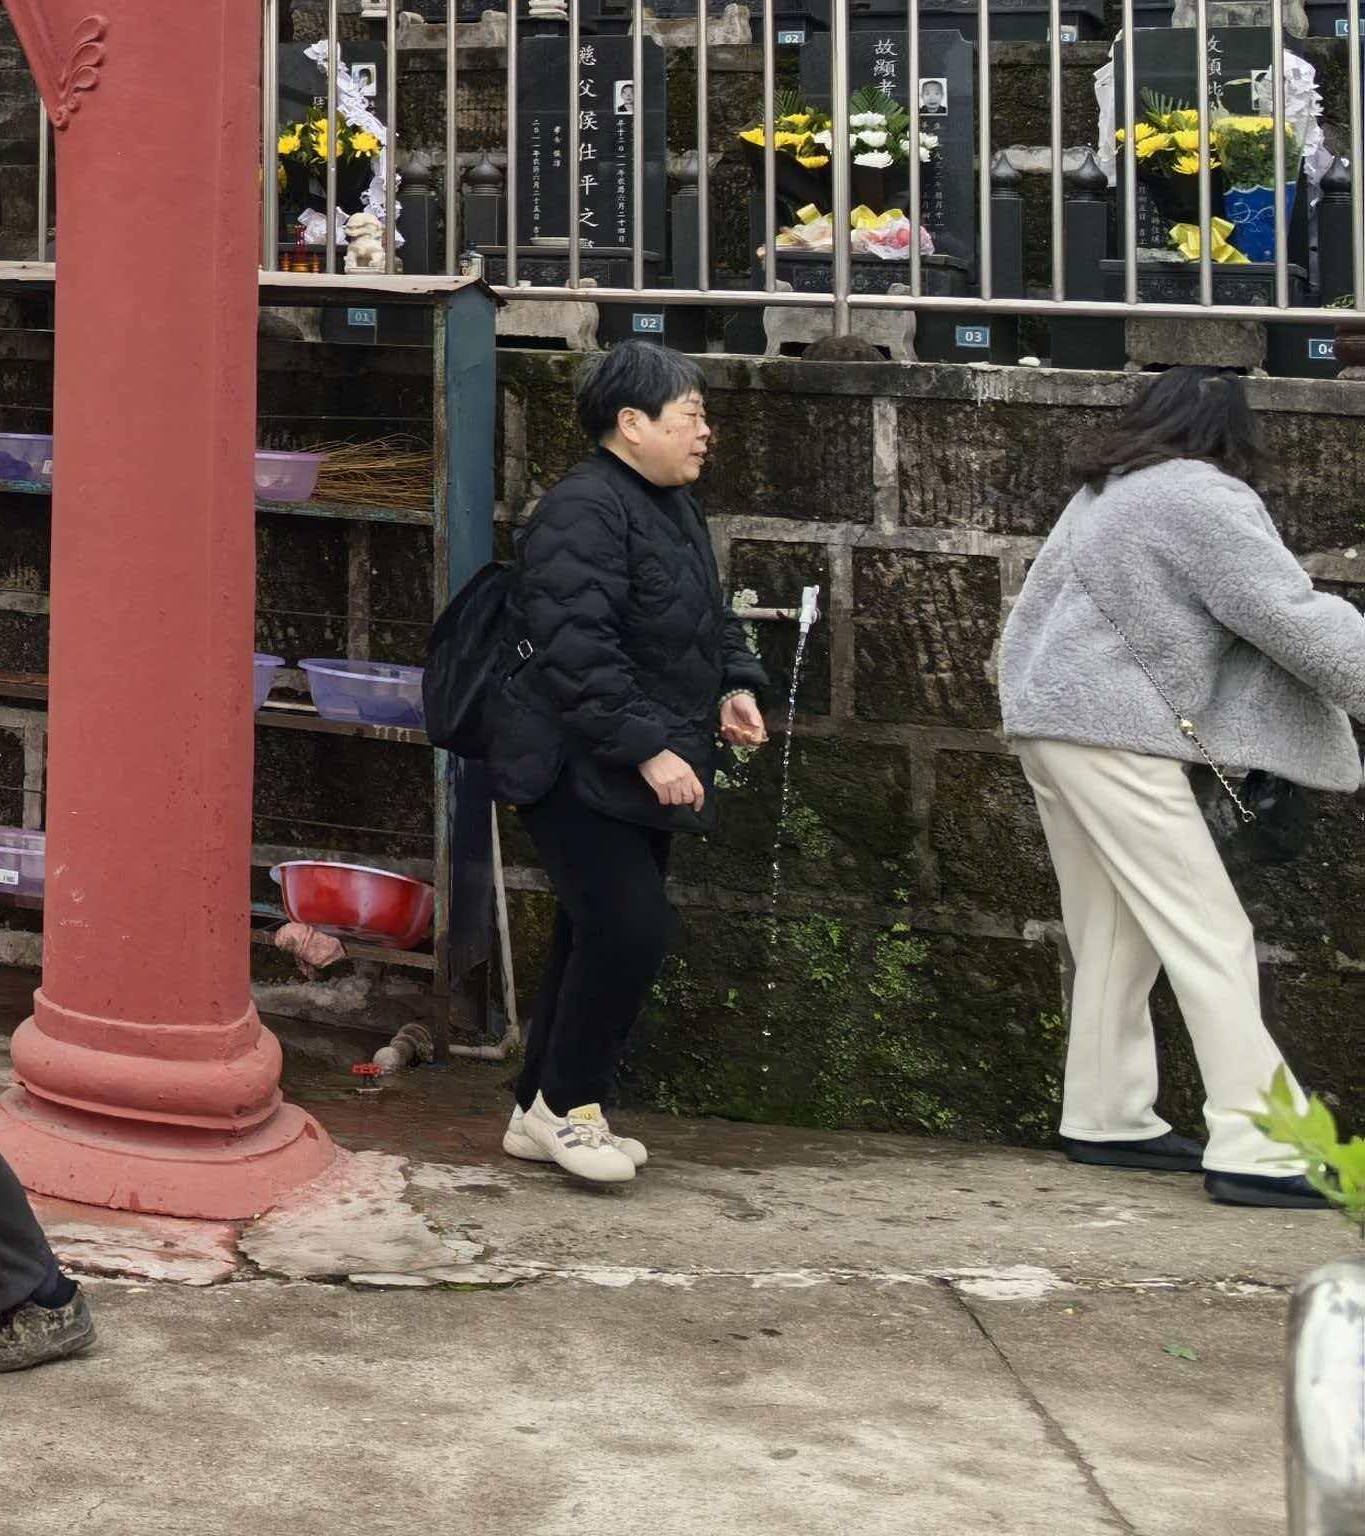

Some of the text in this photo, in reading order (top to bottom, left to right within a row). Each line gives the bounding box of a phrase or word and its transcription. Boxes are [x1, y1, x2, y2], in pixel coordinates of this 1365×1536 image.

[784, 33, 799, 44] 02
[354, 312, 369, 323] 01
[639, 317, 657, 329] 02
[964, 330, 982, 343] 03
